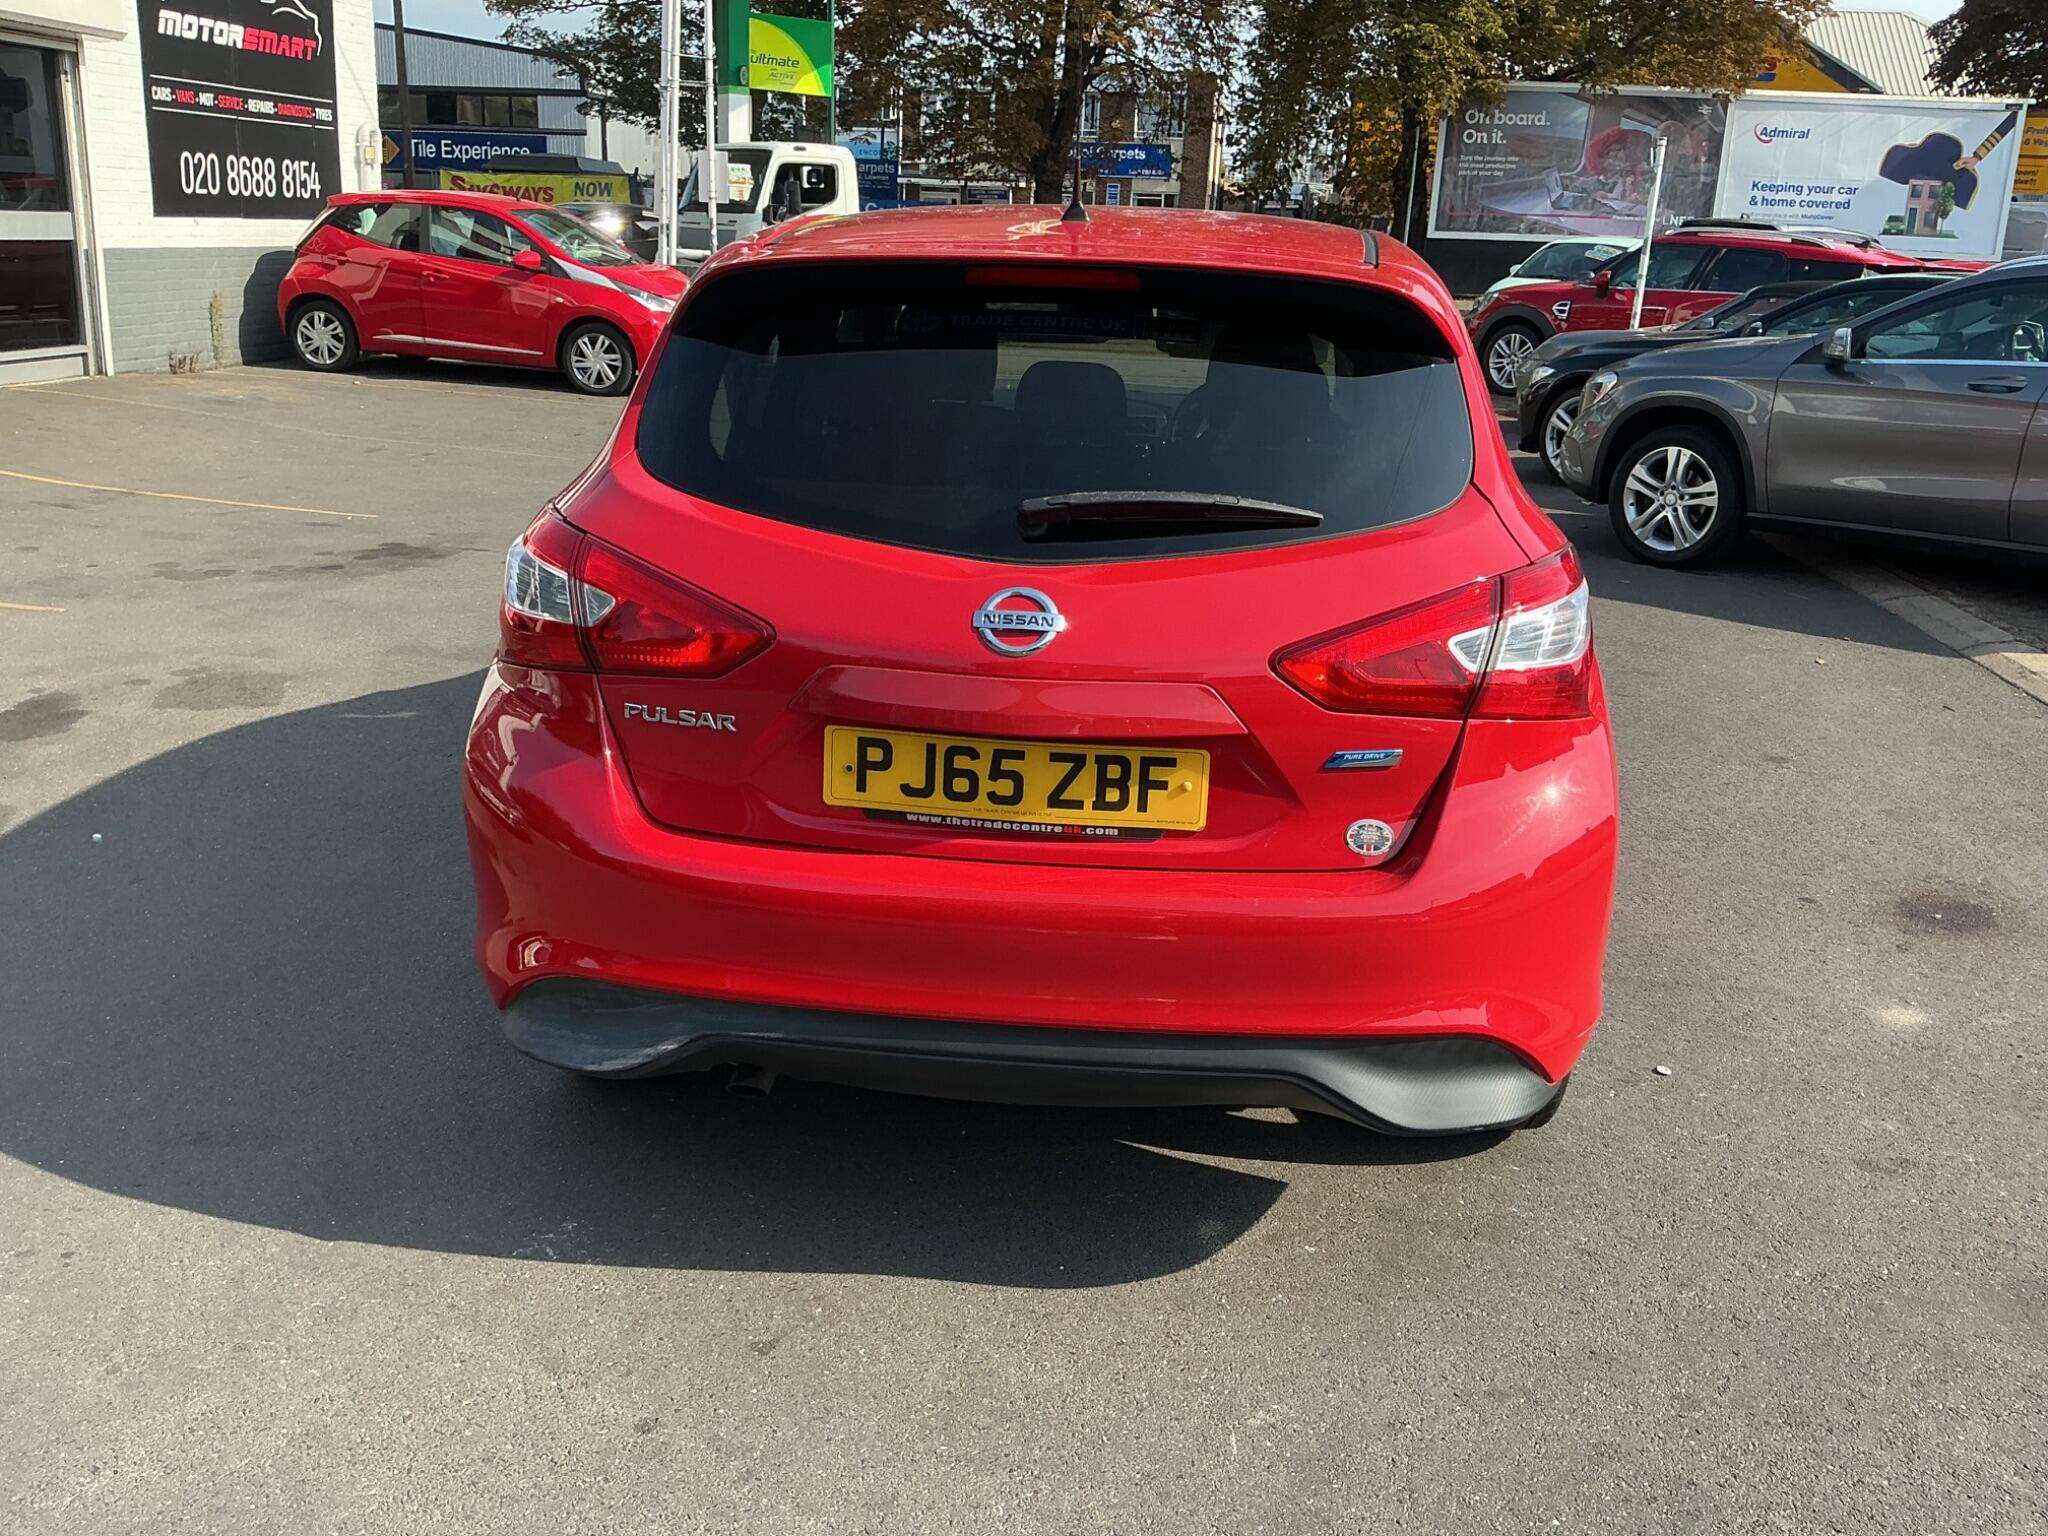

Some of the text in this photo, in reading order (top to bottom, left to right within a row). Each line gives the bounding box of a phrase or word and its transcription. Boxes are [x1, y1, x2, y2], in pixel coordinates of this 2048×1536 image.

[157, 9, 317, 61] MOTORSMART
[750, 53, 800, 69] ultimate
[151, 86, 333, 122] CARS VANS MOT SERVICE REPAIRS DIAGNOSTICS TYRES
[1465, 109, 1551, 126] On board.
[1463, 128, 1507, 144] On it.
[1760, 127, 1811, 140] Admiral
[410, 138, 437, 158] Tile
[180, 150, 321, 199] 020 8688 8154
[858, 163, 895, 174] arpets
[574, 181, 613, 197] NOW
[1751, 181, 1859, 196] Keeping your car
[1749, 195, 1851, 210] & home covered
[982, 613, 1054, 628] NISSAN
[624, 702, 736, 732] PULSAR
[856, 736, 1177, 813] PJ65 ZBF
[906, 812, 1119, 837] www.thetradecentreuk.com
